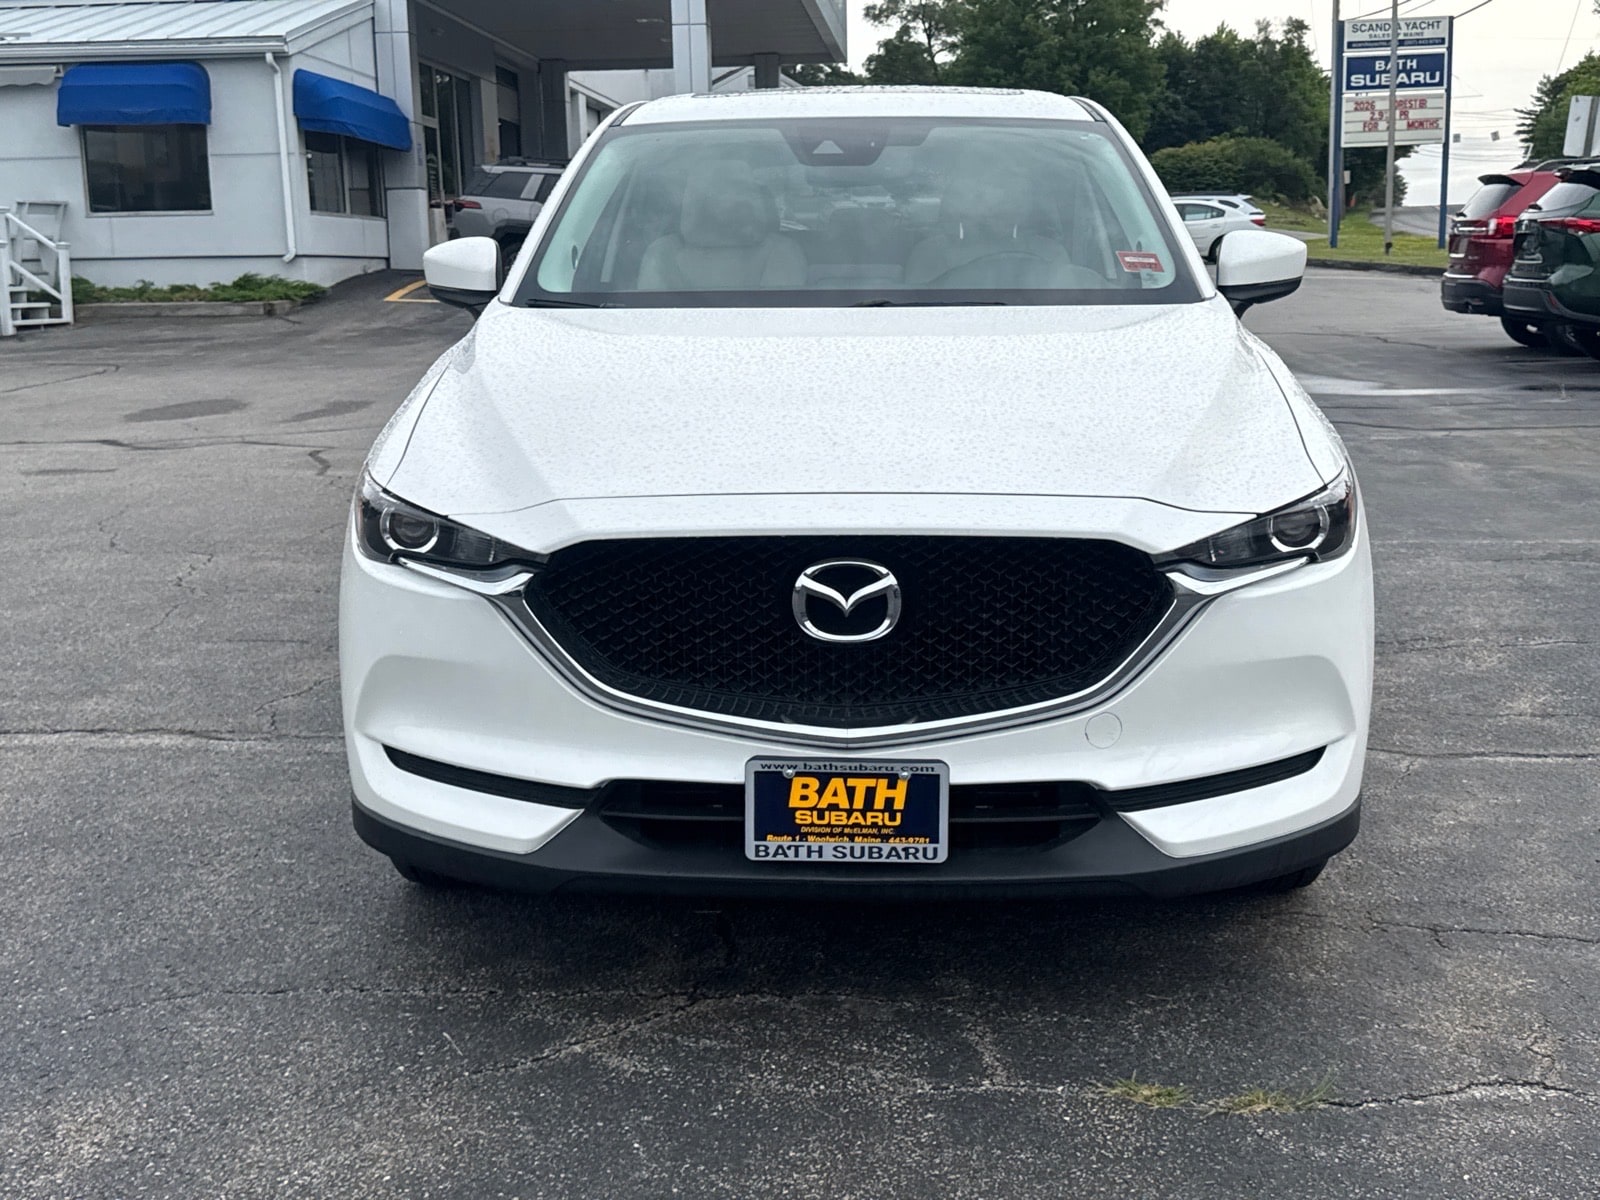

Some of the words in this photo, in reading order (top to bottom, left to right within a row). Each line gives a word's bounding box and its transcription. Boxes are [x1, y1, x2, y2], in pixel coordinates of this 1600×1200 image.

[1351, 22, 1402, 34] SCANDA
[1404, 20, 1442, 31] YACHT
[1350, 72, 1440, 86] SUBARU
[1354, 101, 1375, 111] 2026
[1362, 120, 1379, 132] FOR
[1406, 119, 1439, 131] MONTHS
[760, 762, 936, 773] www.bathsubaru.com
[788, 776, 909, 810] BATH
[794, 810, 902, 826] SUBARU
[800, 826, 831, 834] DIVISION
[766, 834, 794, 842] Route
[754, 844, 824, 859] BATH
[832, 845, 938, 861] SUBARU
